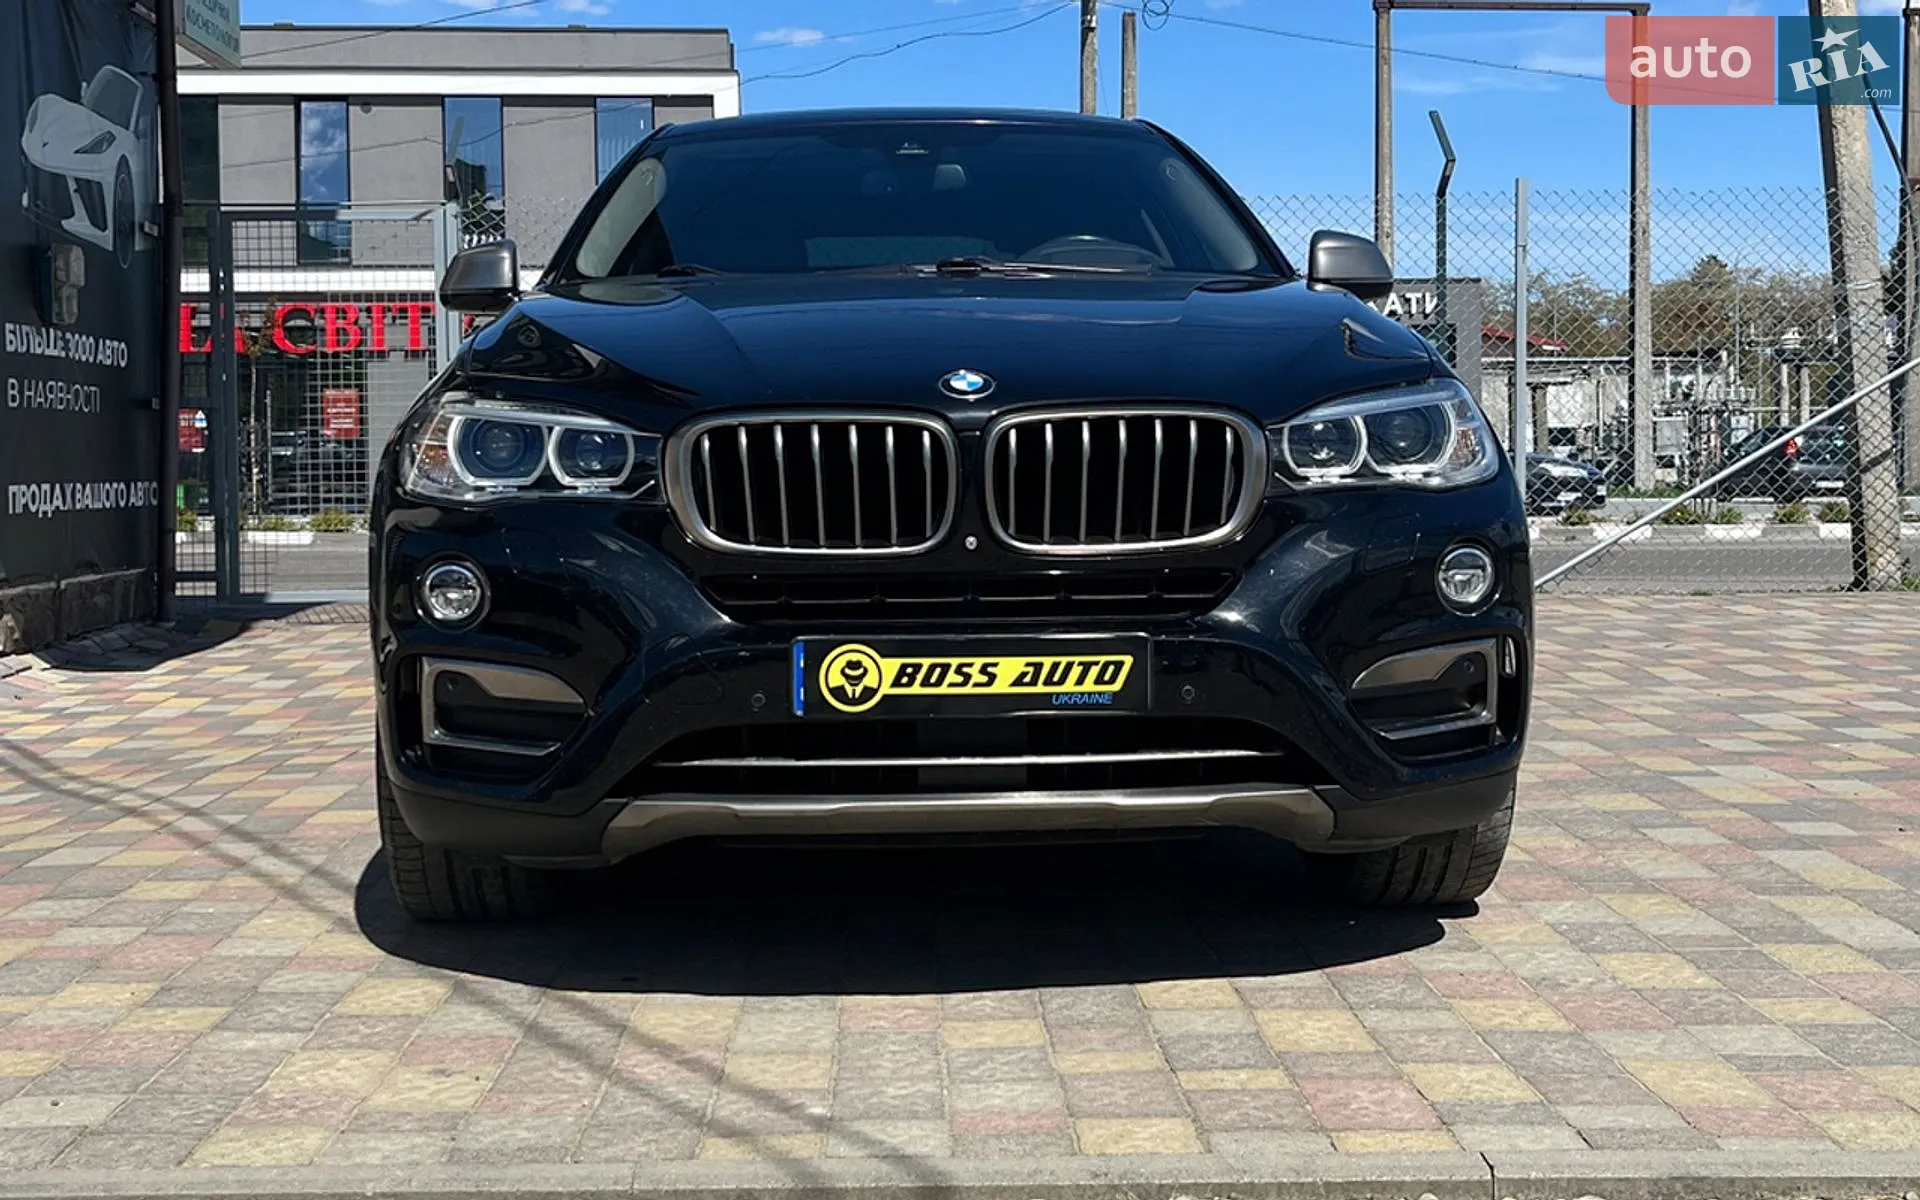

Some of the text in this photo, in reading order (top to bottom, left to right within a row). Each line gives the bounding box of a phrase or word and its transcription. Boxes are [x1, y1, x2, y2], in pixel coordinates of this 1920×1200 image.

[5, 322, 66, 358] БІЛЬШЕ
[96, 337, 128, 368] АВТО
[7, 377, 20, 408] В
[128, 480, 159, 507] АВТО
[889, 659, 1126, 689] BOSS AUTO
[1051, 692, 1113, 706] UKRAINE
